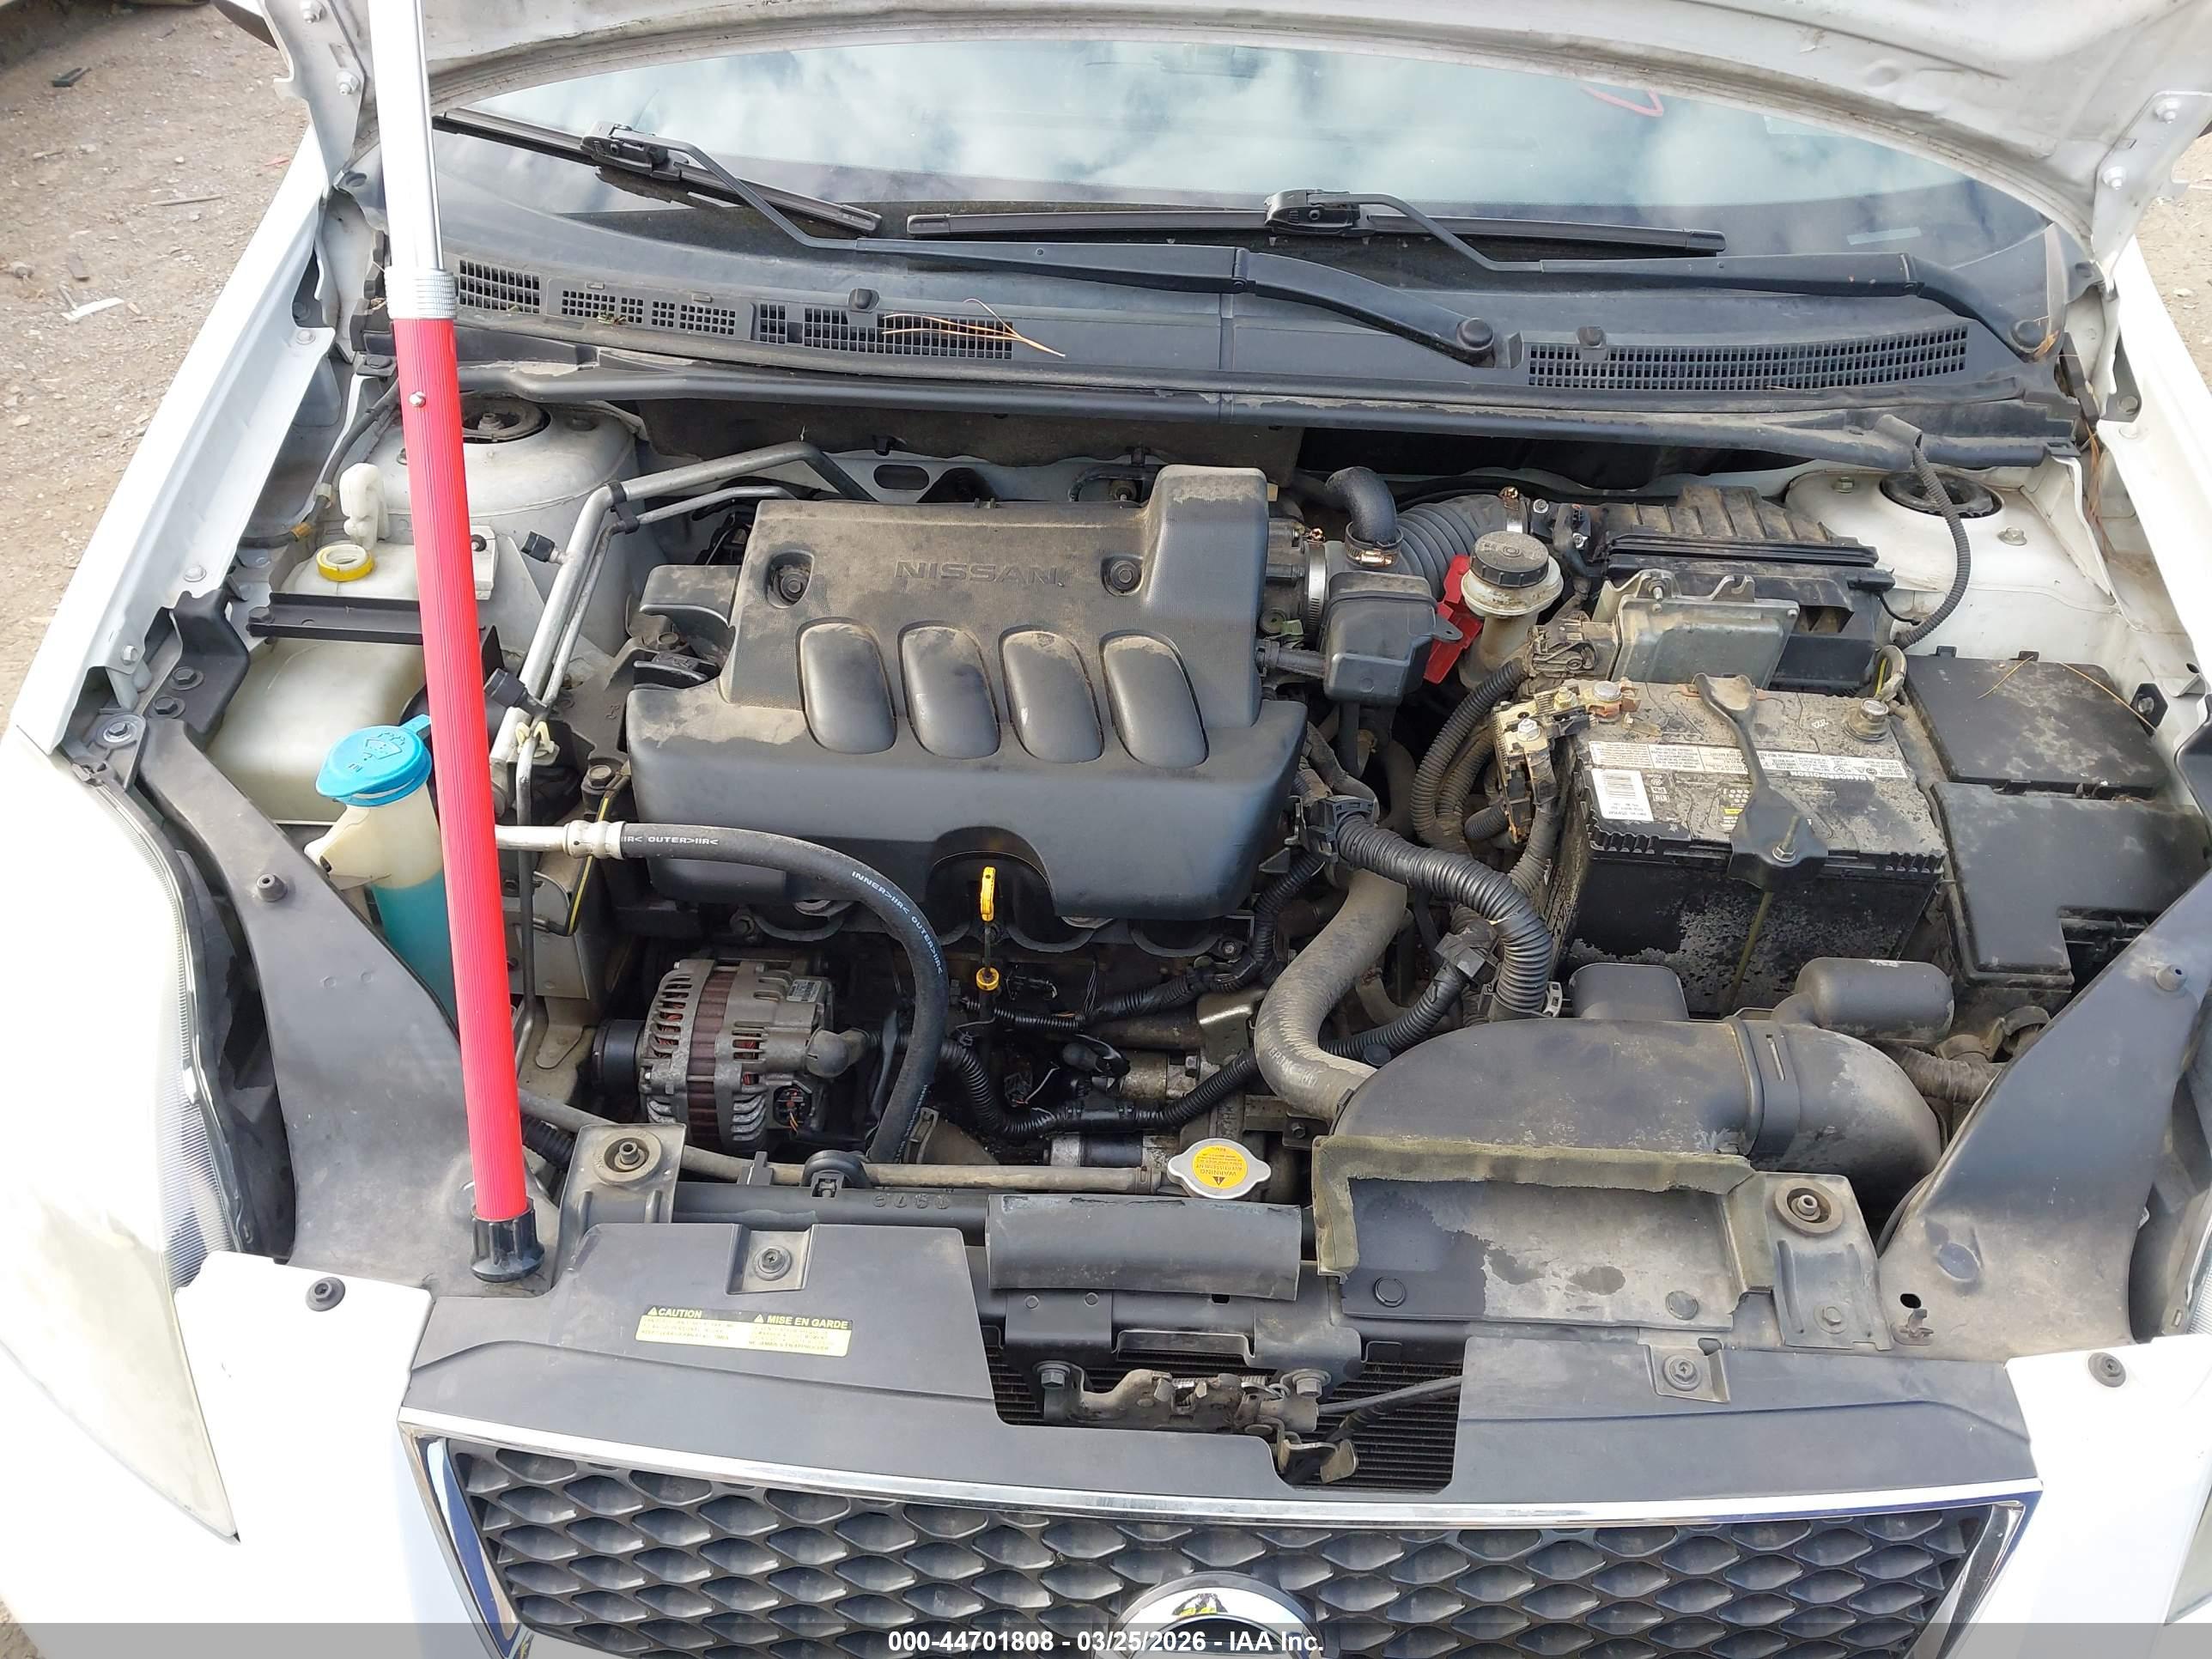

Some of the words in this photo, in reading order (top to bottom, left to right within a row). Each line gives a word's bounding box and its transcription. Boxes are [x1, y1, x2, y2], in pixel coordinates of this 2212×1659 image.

[894, 561, 1057, 586] NISSAN
[658, 1307, 702, 1319] CAUTION
[767, 1315, 793, 1326] MISE
[794, 1316, 812, 1327] EN
[813, 1318, 849, 1330] GARDE
